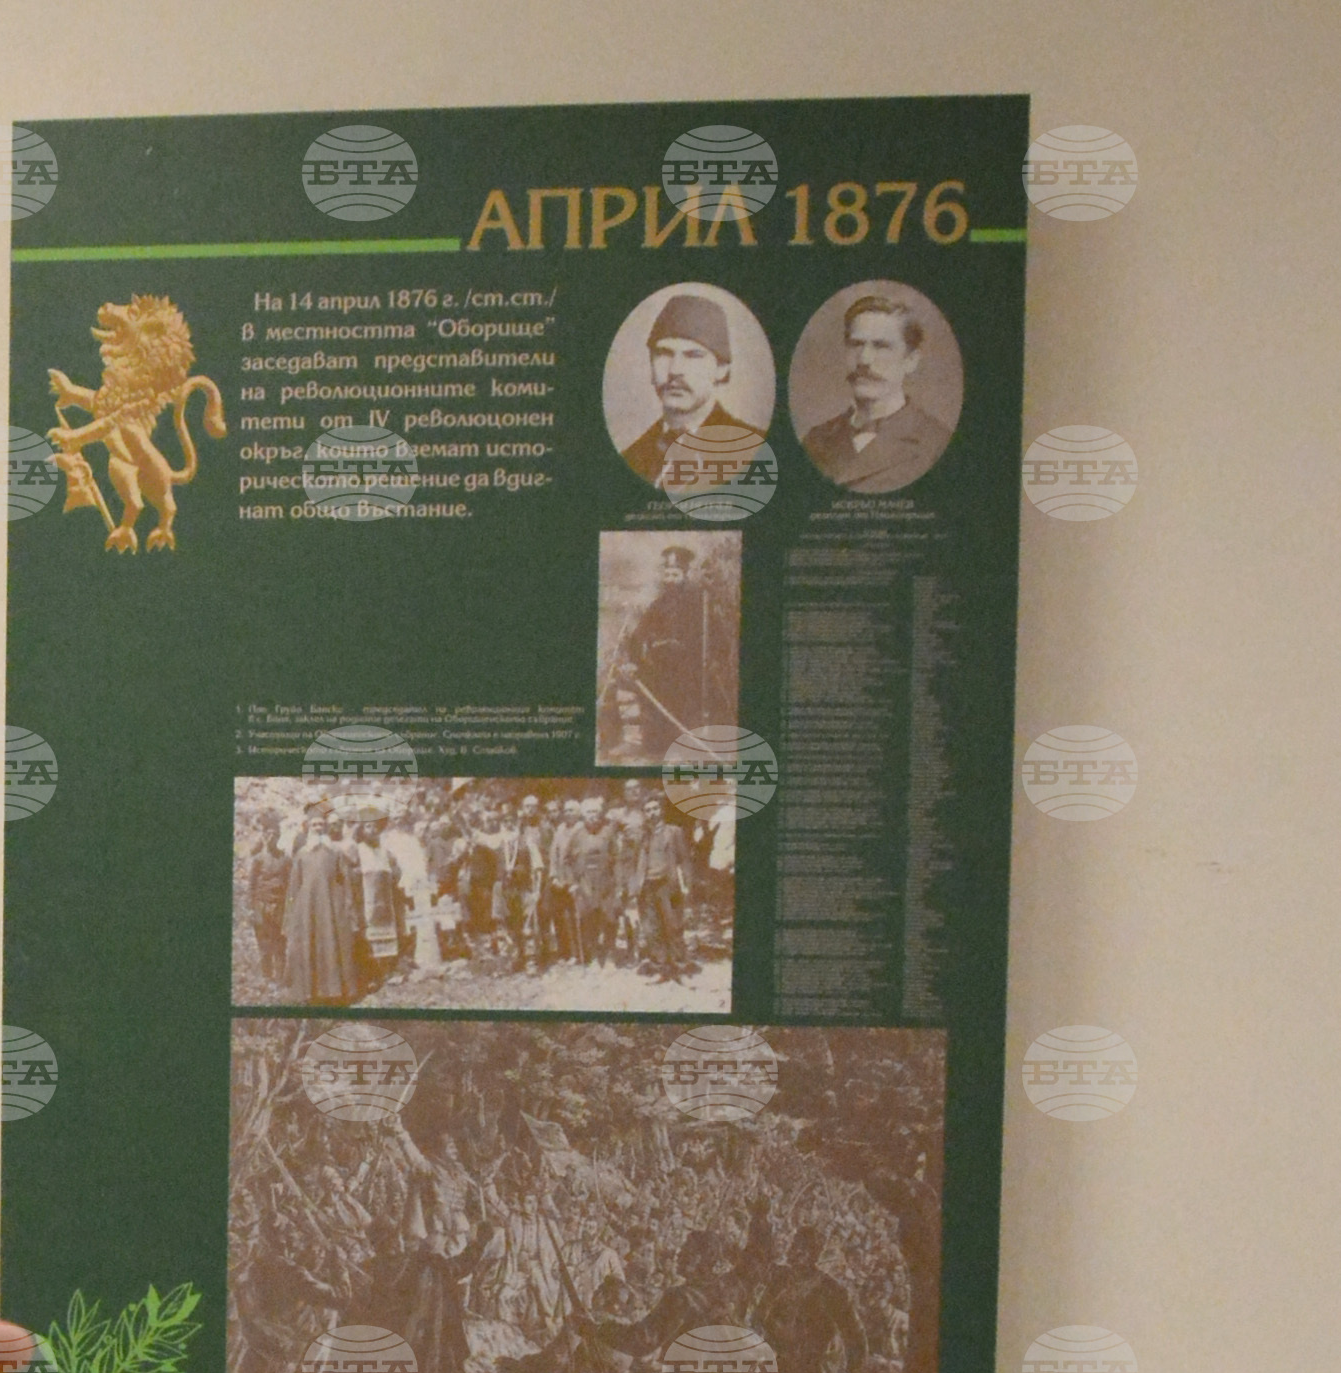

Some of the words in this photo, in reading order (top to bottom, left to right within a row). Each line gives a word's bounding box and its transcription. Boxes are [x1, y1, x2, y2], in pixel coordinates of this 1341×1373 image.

[467, 183, 757, 253] АПРИЛ
[781, 180, 969, 247] 1876
[254, 293, 282, 311] На
[290, 292, 312, 311] 14
[318, 294, 381, 314] април
[388, 289, 438, 309] 1876
[442, 293, 459, 308] г.
[242, 323, 255, 341] в
[266, 323, 415, 341] местността
[242, 351, 358, 374] заседават
[374, 349, 555, 373] представители
[241, 385, 265, 400] на
[281, 381, 476, 404] революционните
[491, 378, 555, 397] коми-
[241, 415, 305, 430] тети
[320, 413, 353, 429] от
[369, 409, 390, 428] IV
[404, 409, 554, 433] революцонен
[240, 443, 309, 464] окръг,
[316, 441, 388, 459] които
[396, 440, 479, 459] вземат
[486, 441, 554, 458] исто-
[239, 474, 359, 493] рическото
[365, 473, 461, 494] решение
[464, 472, 489, 493] да
[494, 468, 554, 491] вдиг-
[239, 503, 283, 519] нат
[290, 501, 350, 521] общо
[357, 500, 472, 519] въстание.
